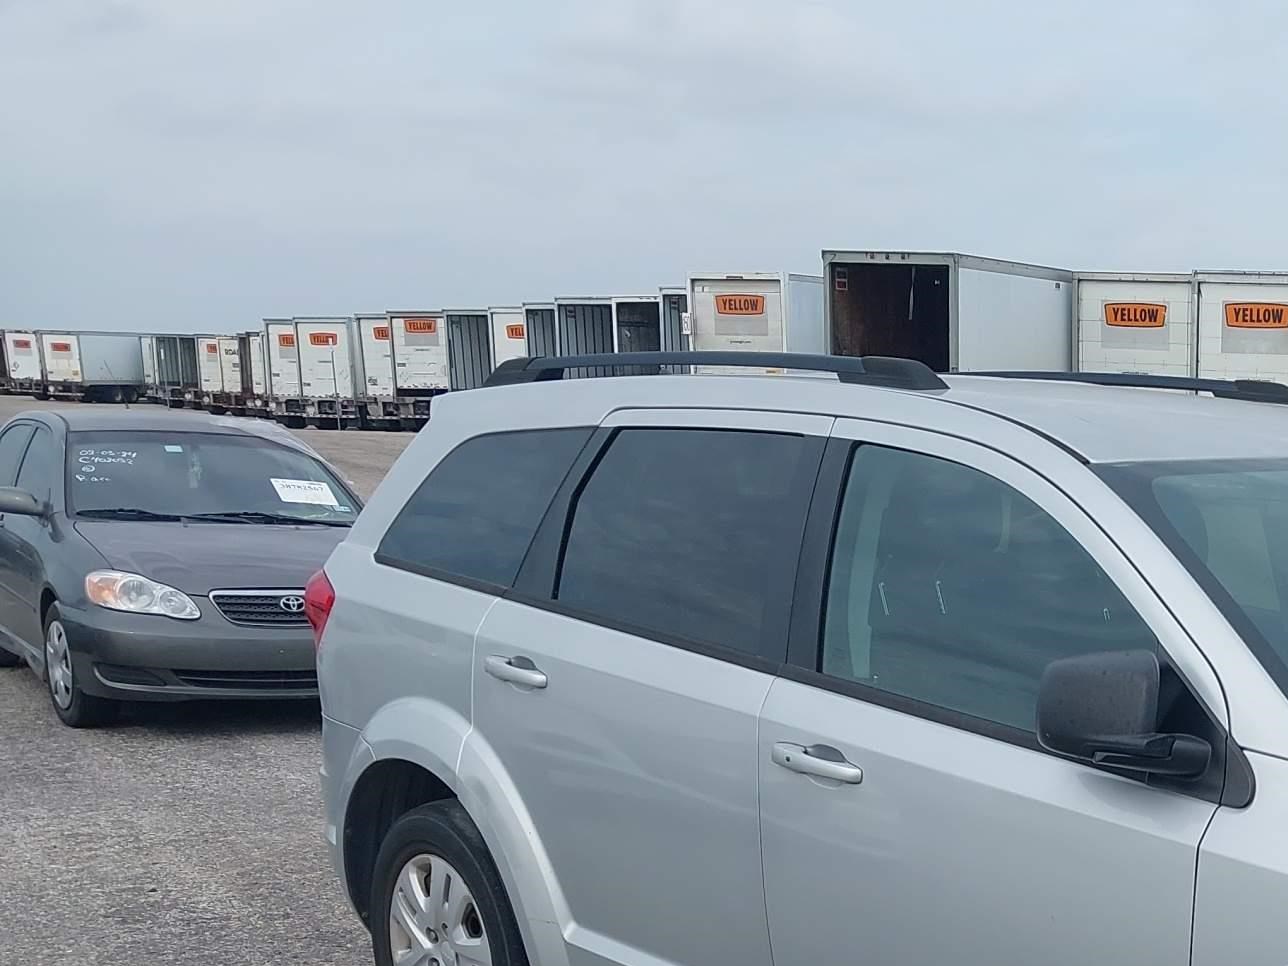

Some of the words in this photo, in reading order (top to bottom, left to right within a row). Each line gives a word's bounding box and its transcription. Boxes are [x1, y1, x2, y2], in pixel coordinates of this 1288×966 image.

[722, 299, 758, 312] YELLOW
[1113, 307, 1159, 323] YELLOW
[1233, 307, 1284, 324] YELLOW
[408, 322, 433, 331] YELLOW
